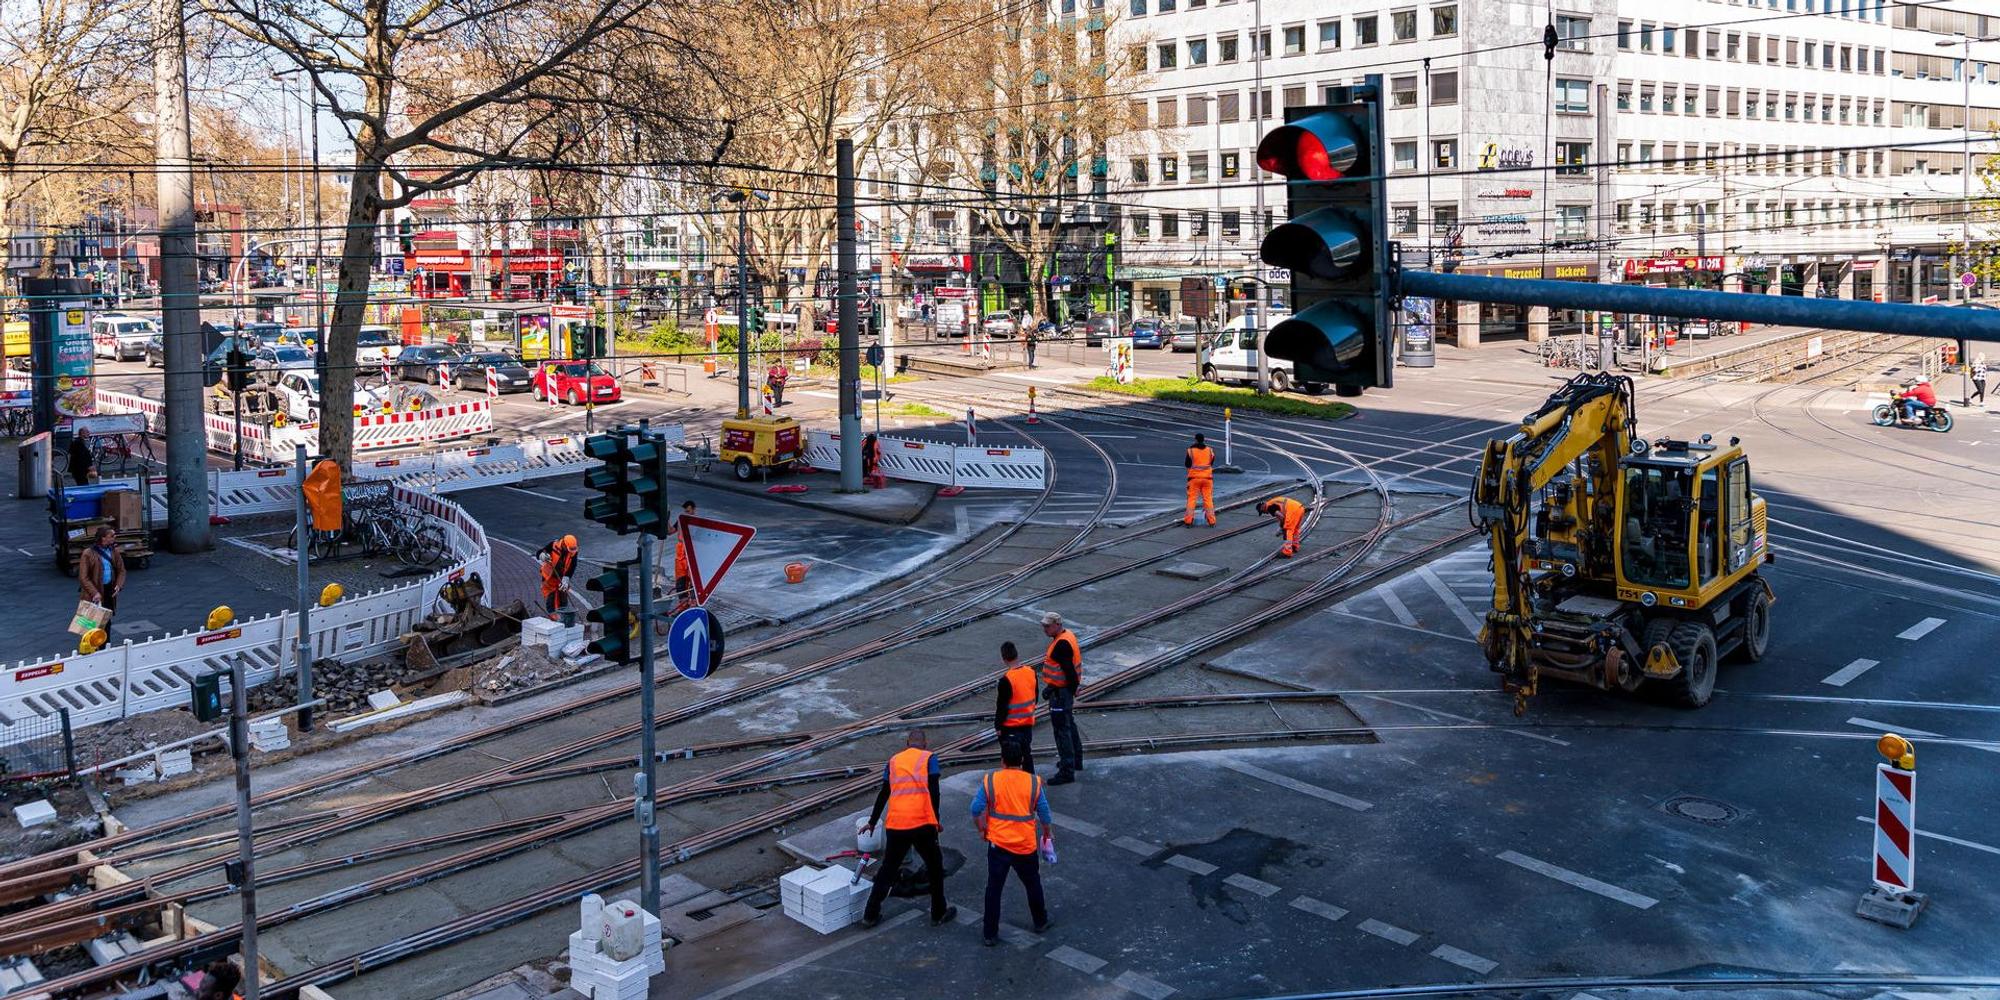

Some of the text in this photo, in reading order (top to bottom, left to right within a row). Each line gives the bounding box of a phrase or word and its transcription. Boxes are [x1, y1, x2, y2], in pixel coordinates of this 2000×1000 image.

[1555, 265, 1586, 277] Bäckerei
[1618, 590, 1640, 600] 751
[201, 634, 226, 644] ZEPPELIN
[21, 668, 47, 679] ZEPPELIN
